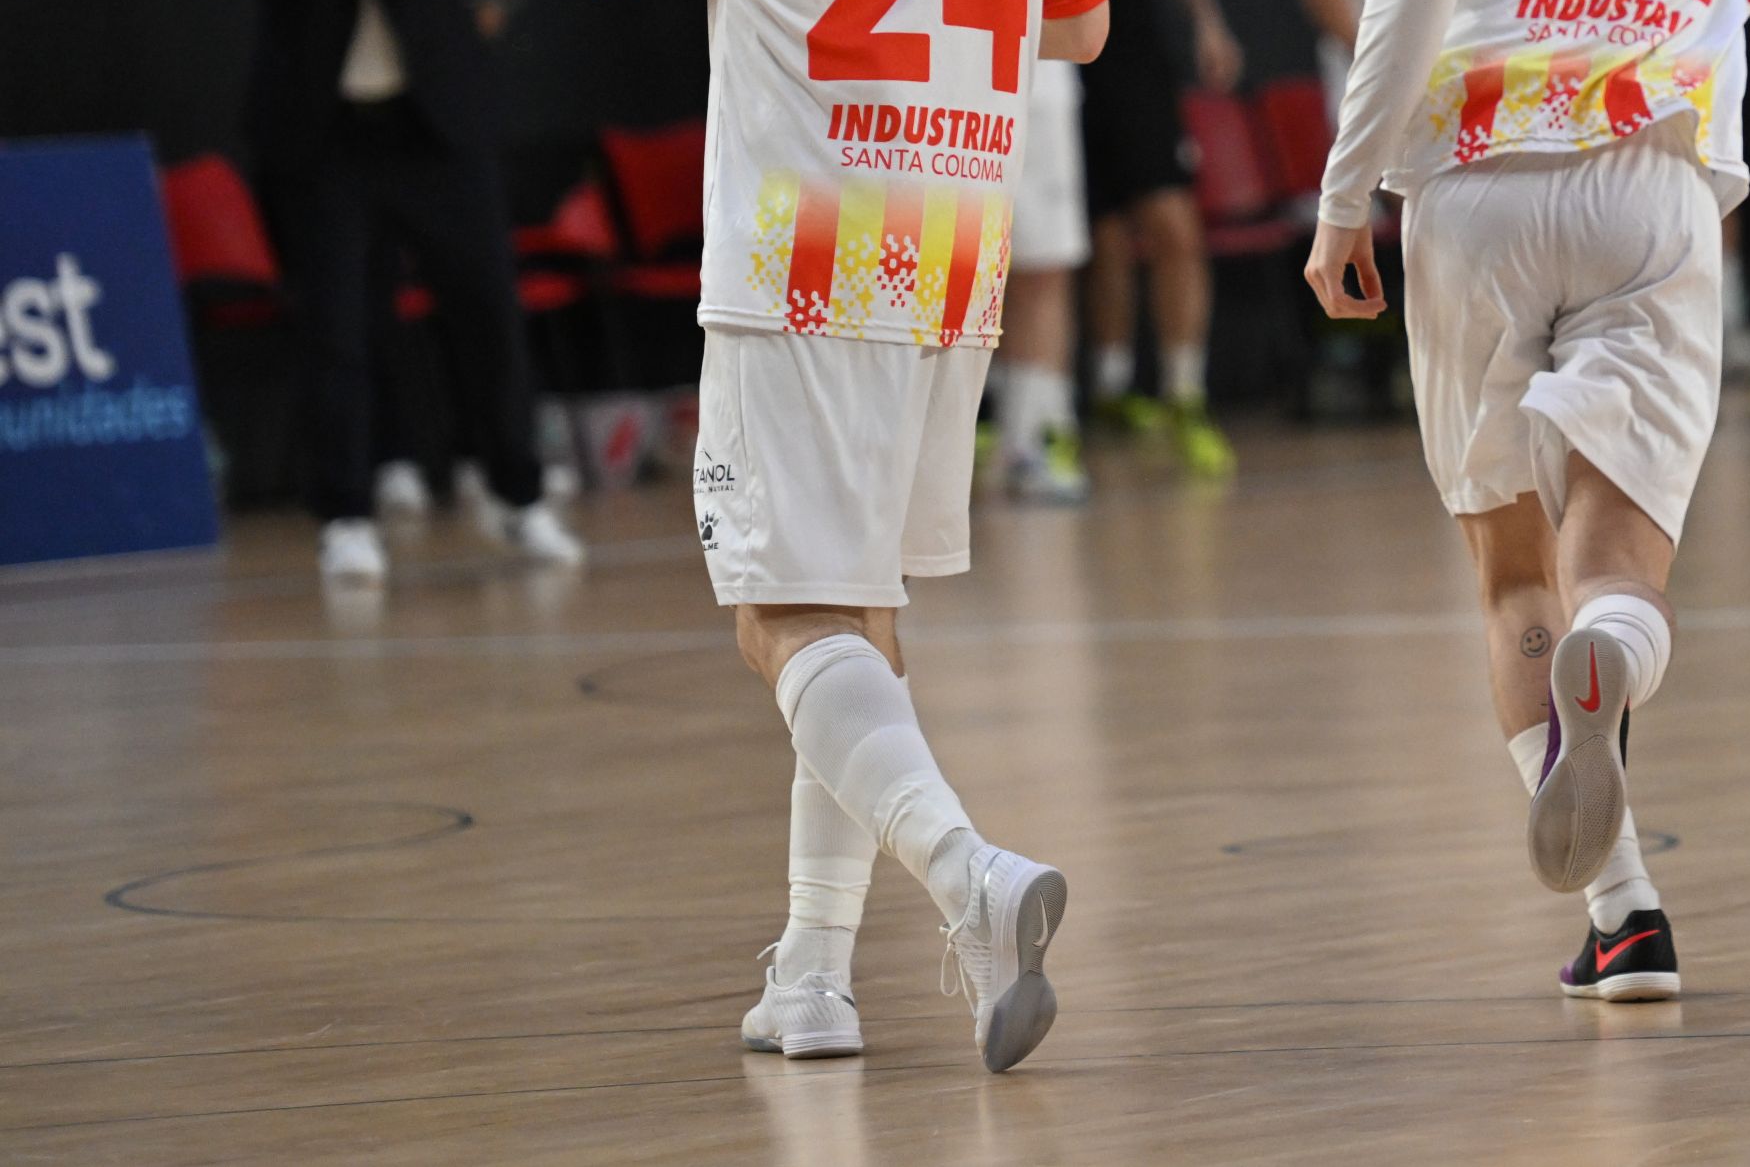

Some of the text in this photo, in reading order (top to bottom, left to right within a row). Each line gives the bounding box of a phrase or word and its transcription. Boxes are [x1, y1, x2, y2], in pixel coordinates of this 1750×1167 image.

[826, 103, 1015, 157] INDUSTRIAS
[840, 146, 1004, 184] SANTA COLOMA
[0, 251, 116, 388] st
